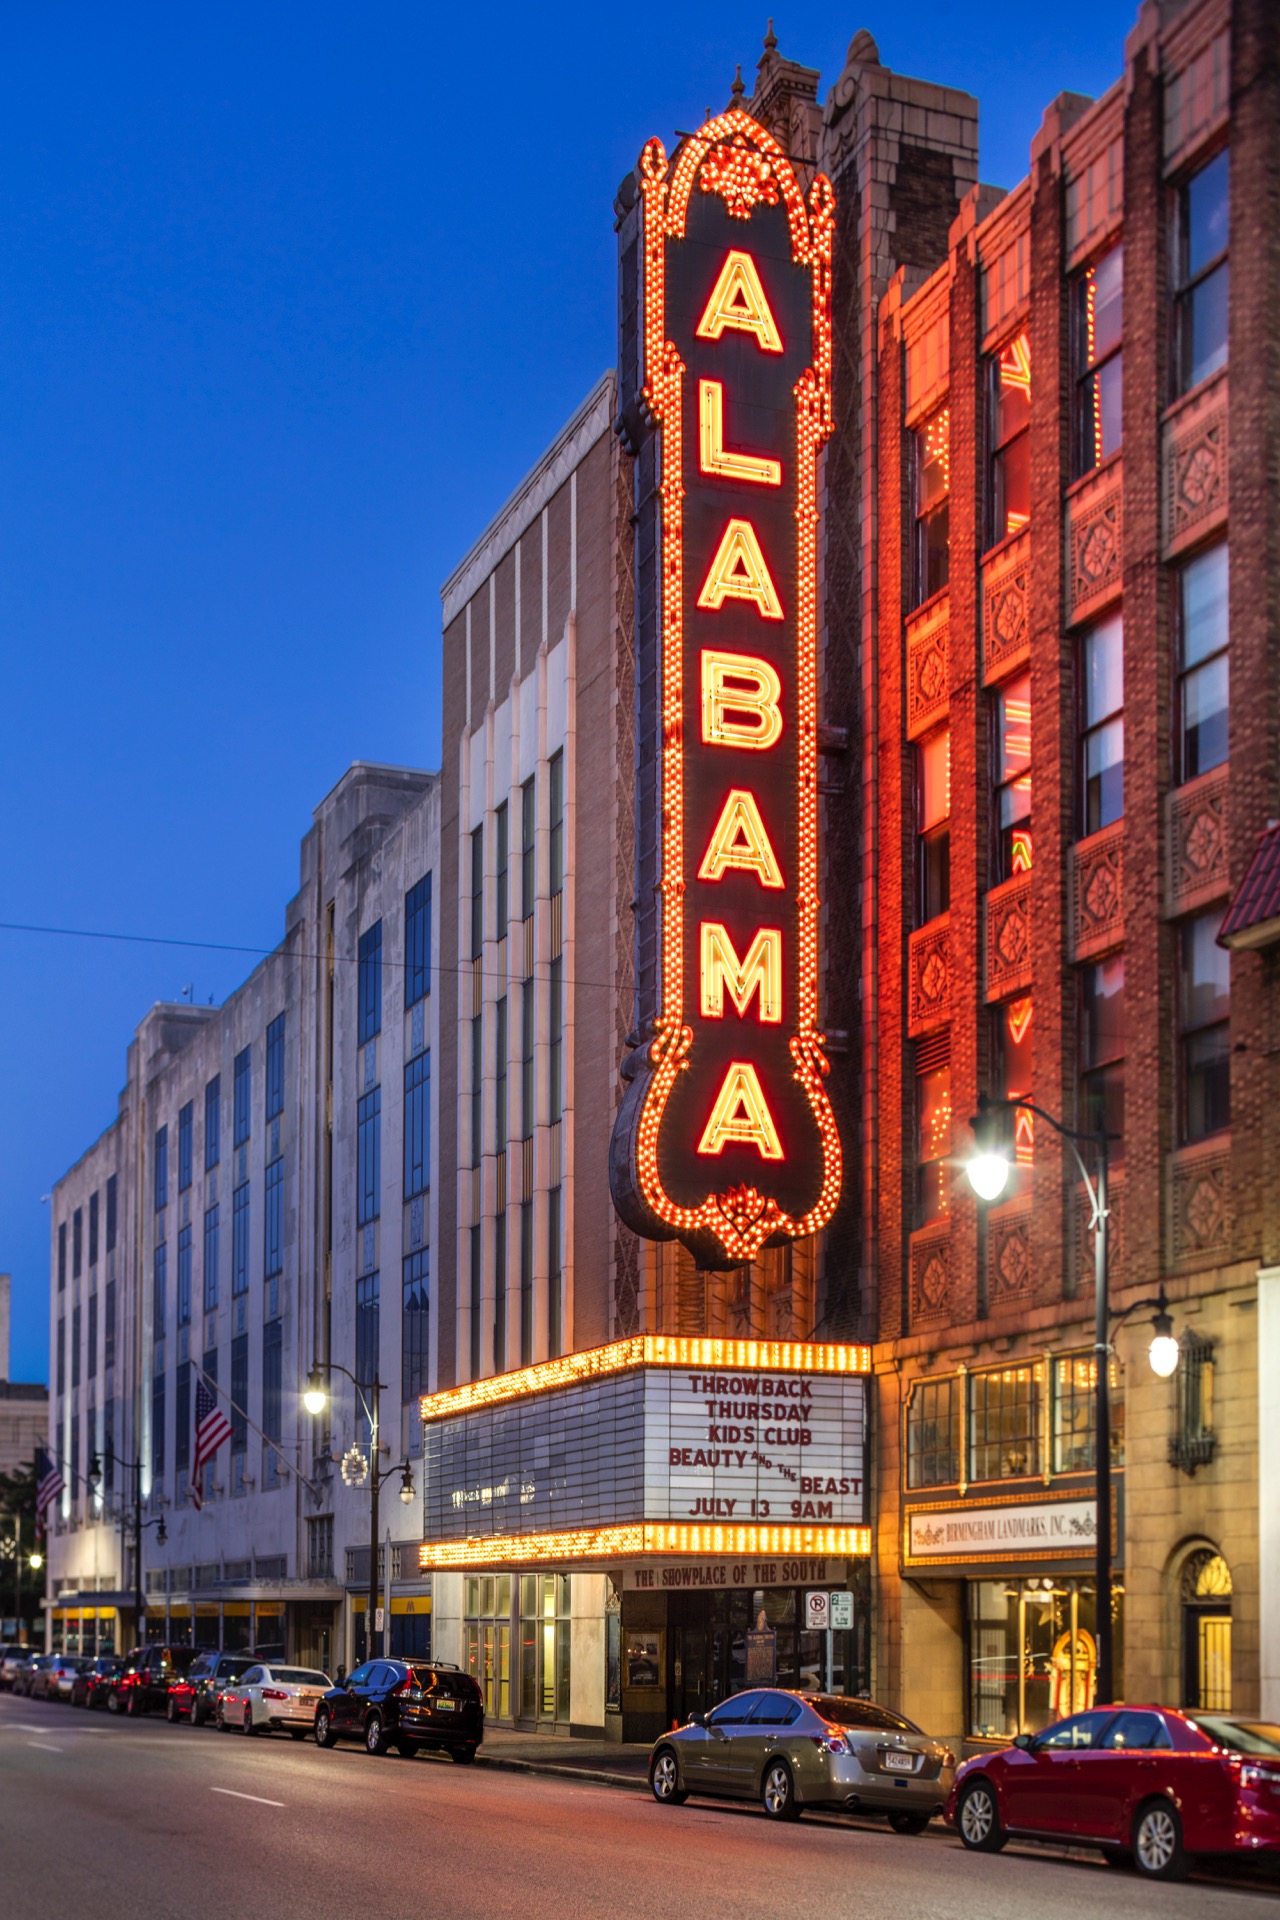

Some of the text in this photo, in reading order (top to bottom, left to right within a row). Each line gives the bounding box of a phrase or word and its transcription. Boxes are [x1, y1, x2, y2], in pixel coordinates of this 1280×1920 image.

[695, 249, 785, 1161] ALABAMA
[688, 1375, 813, 1398] THROWBACK
[705, 1400, 812, 1422] THURSDAY
[709, 1425, 812, 1446] KIDS CLUB
[669, 1448, 862, 1495] BEAUTY AND THE BEAST
[688, 1498, 833, 1519] JULY 13 9AM
[946, 1519, 995, 1543] BIRMINGHAM
[1050, 1515, 1067, 1536] INC.
[635, 1560, 826, 1587] THE SHOWPLACE OF THE SOUTH
